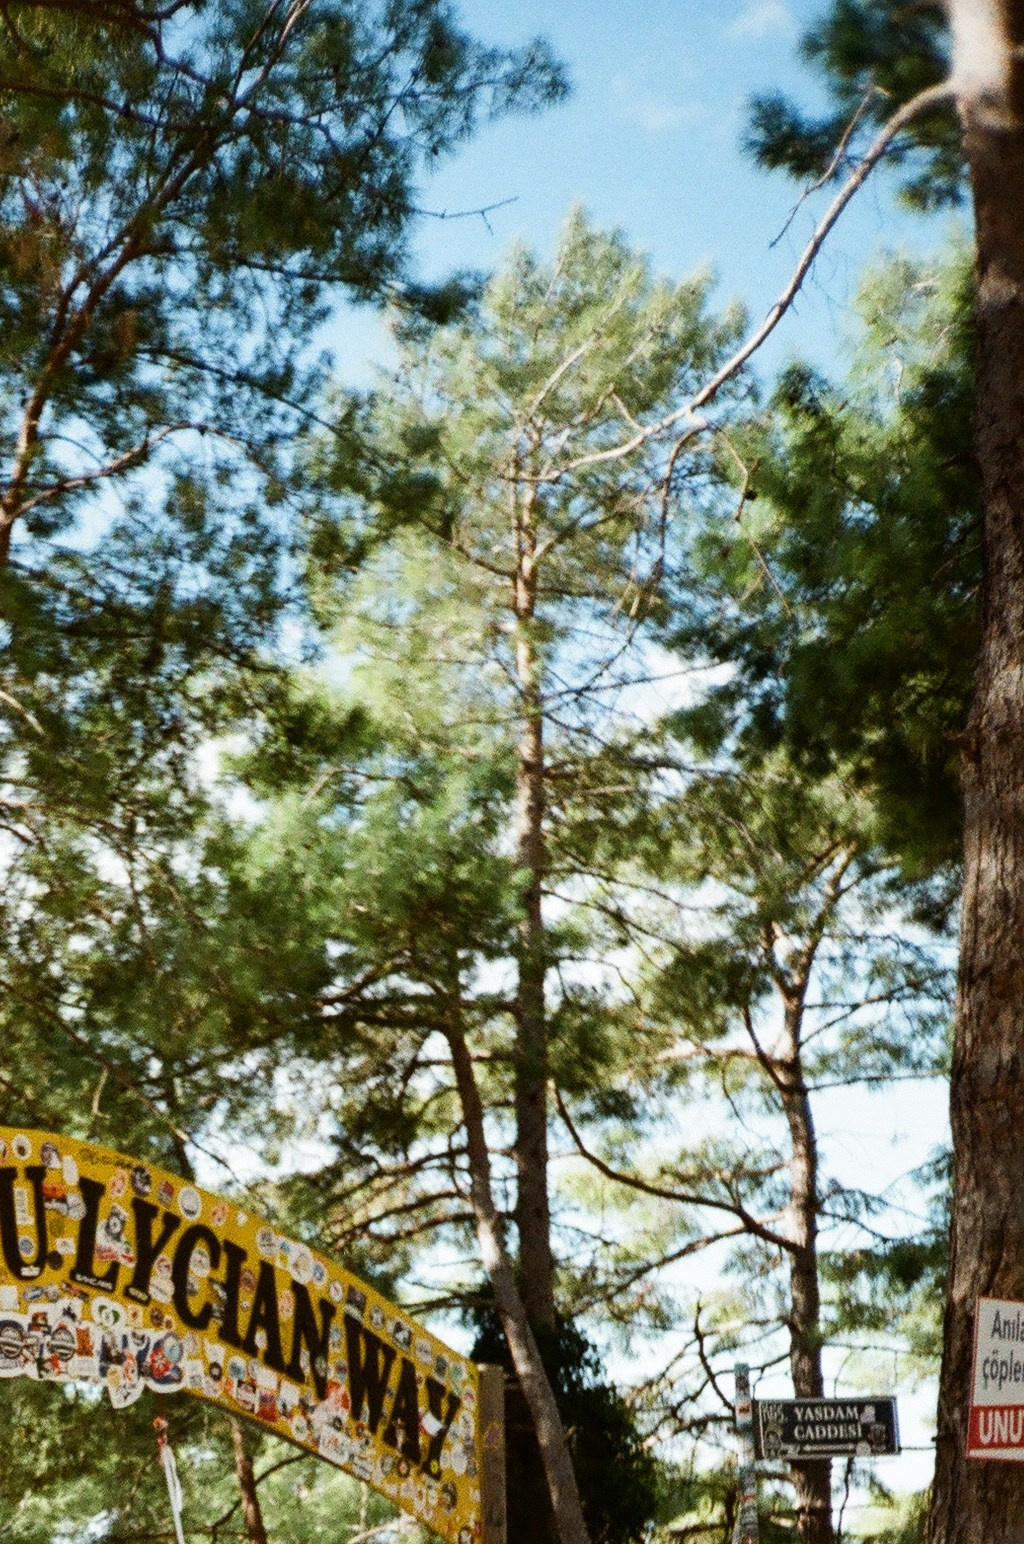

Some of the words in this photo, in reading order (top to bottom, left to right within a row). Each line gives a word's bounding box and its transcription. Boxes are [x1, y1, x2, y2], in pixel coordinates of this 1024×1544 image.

[69, 1176, 336, 1401] LYCIAN
[343, 1313, 463, 1479] WAY
[982, 1348, 1024, 1391] çöple
